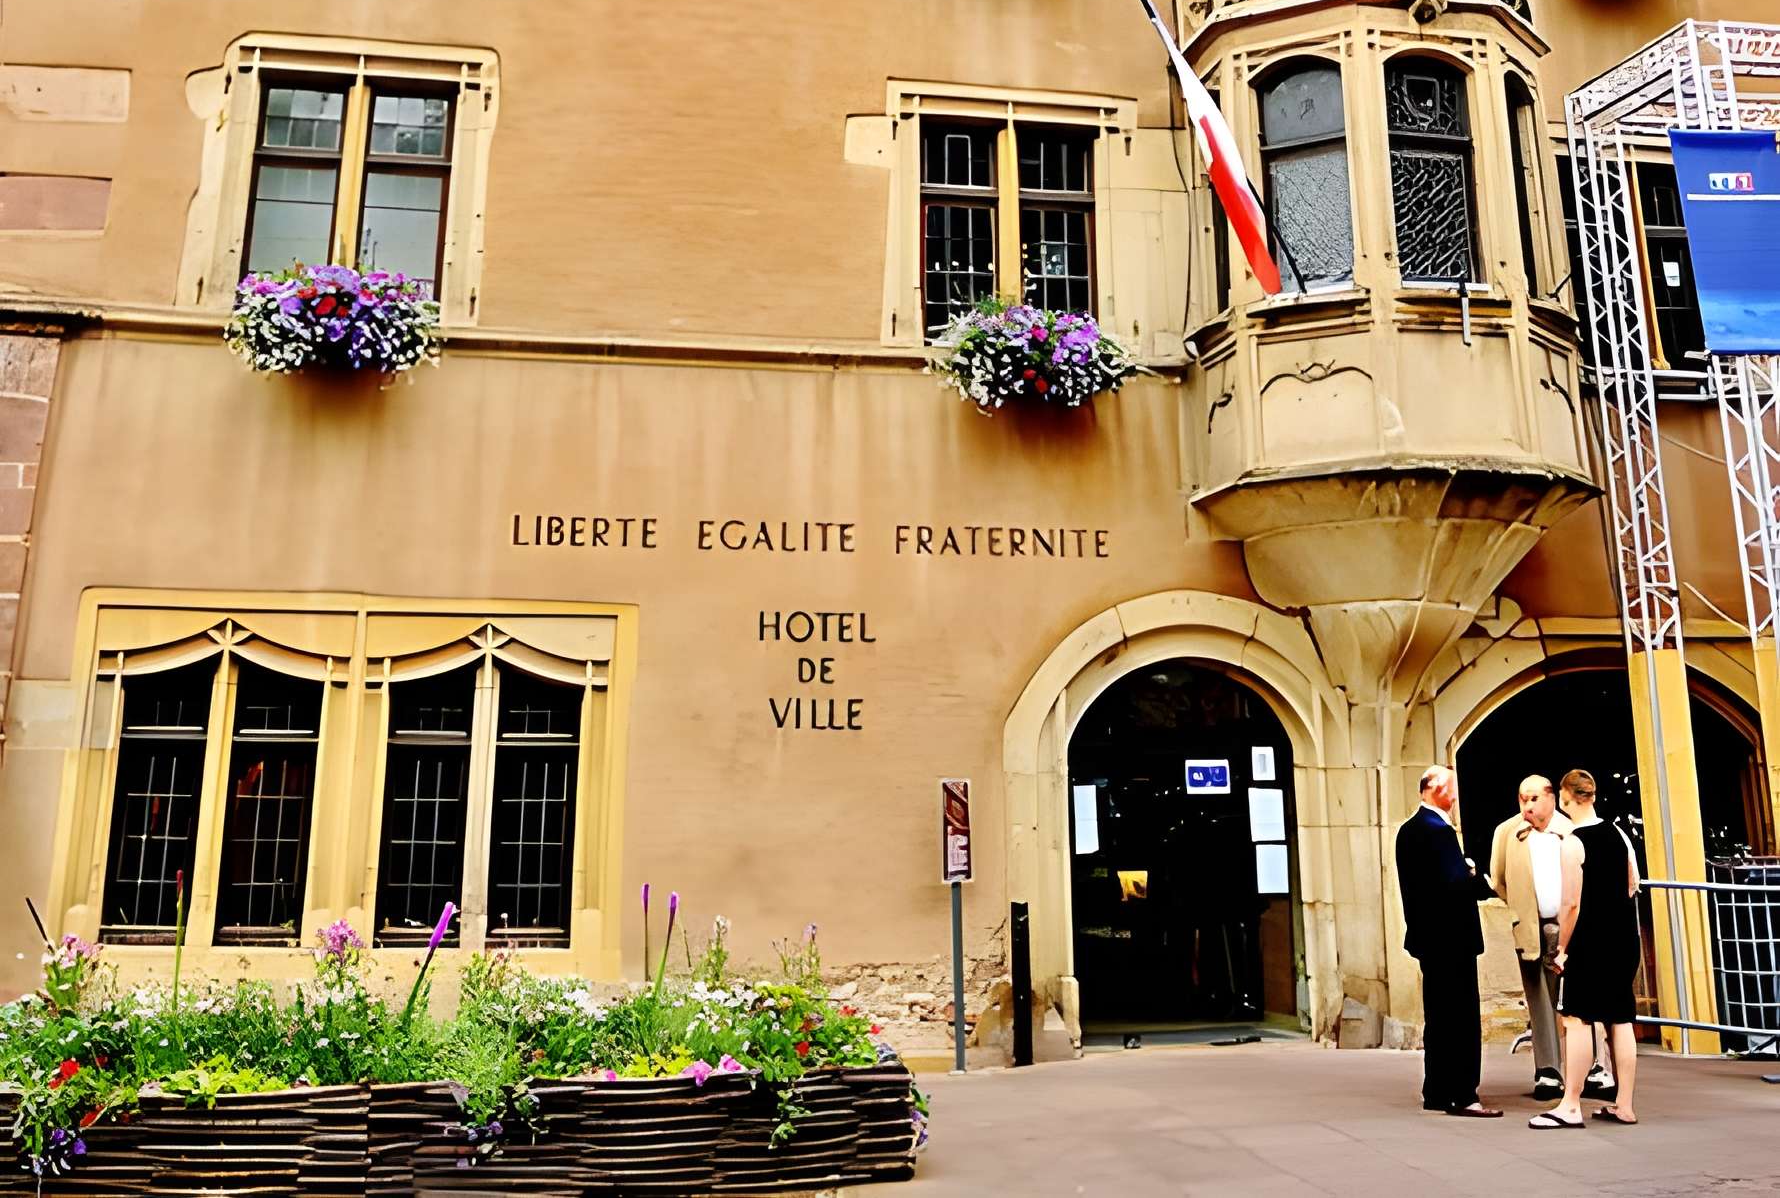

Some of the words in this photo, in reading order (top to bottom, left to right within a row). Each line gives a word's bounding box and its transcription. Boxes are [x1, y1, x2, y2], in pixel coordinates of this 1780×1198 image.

[512, 514, 658, 550] LIBERTE
[697, 519, 856, 554] EGALITE
[895, 525, 1110, 559] FRATERNITE
[758, 610, 878, 645] HOTEL
[797, 657, 836, 685] DE
[768, 697, 865, 732] VILLE
